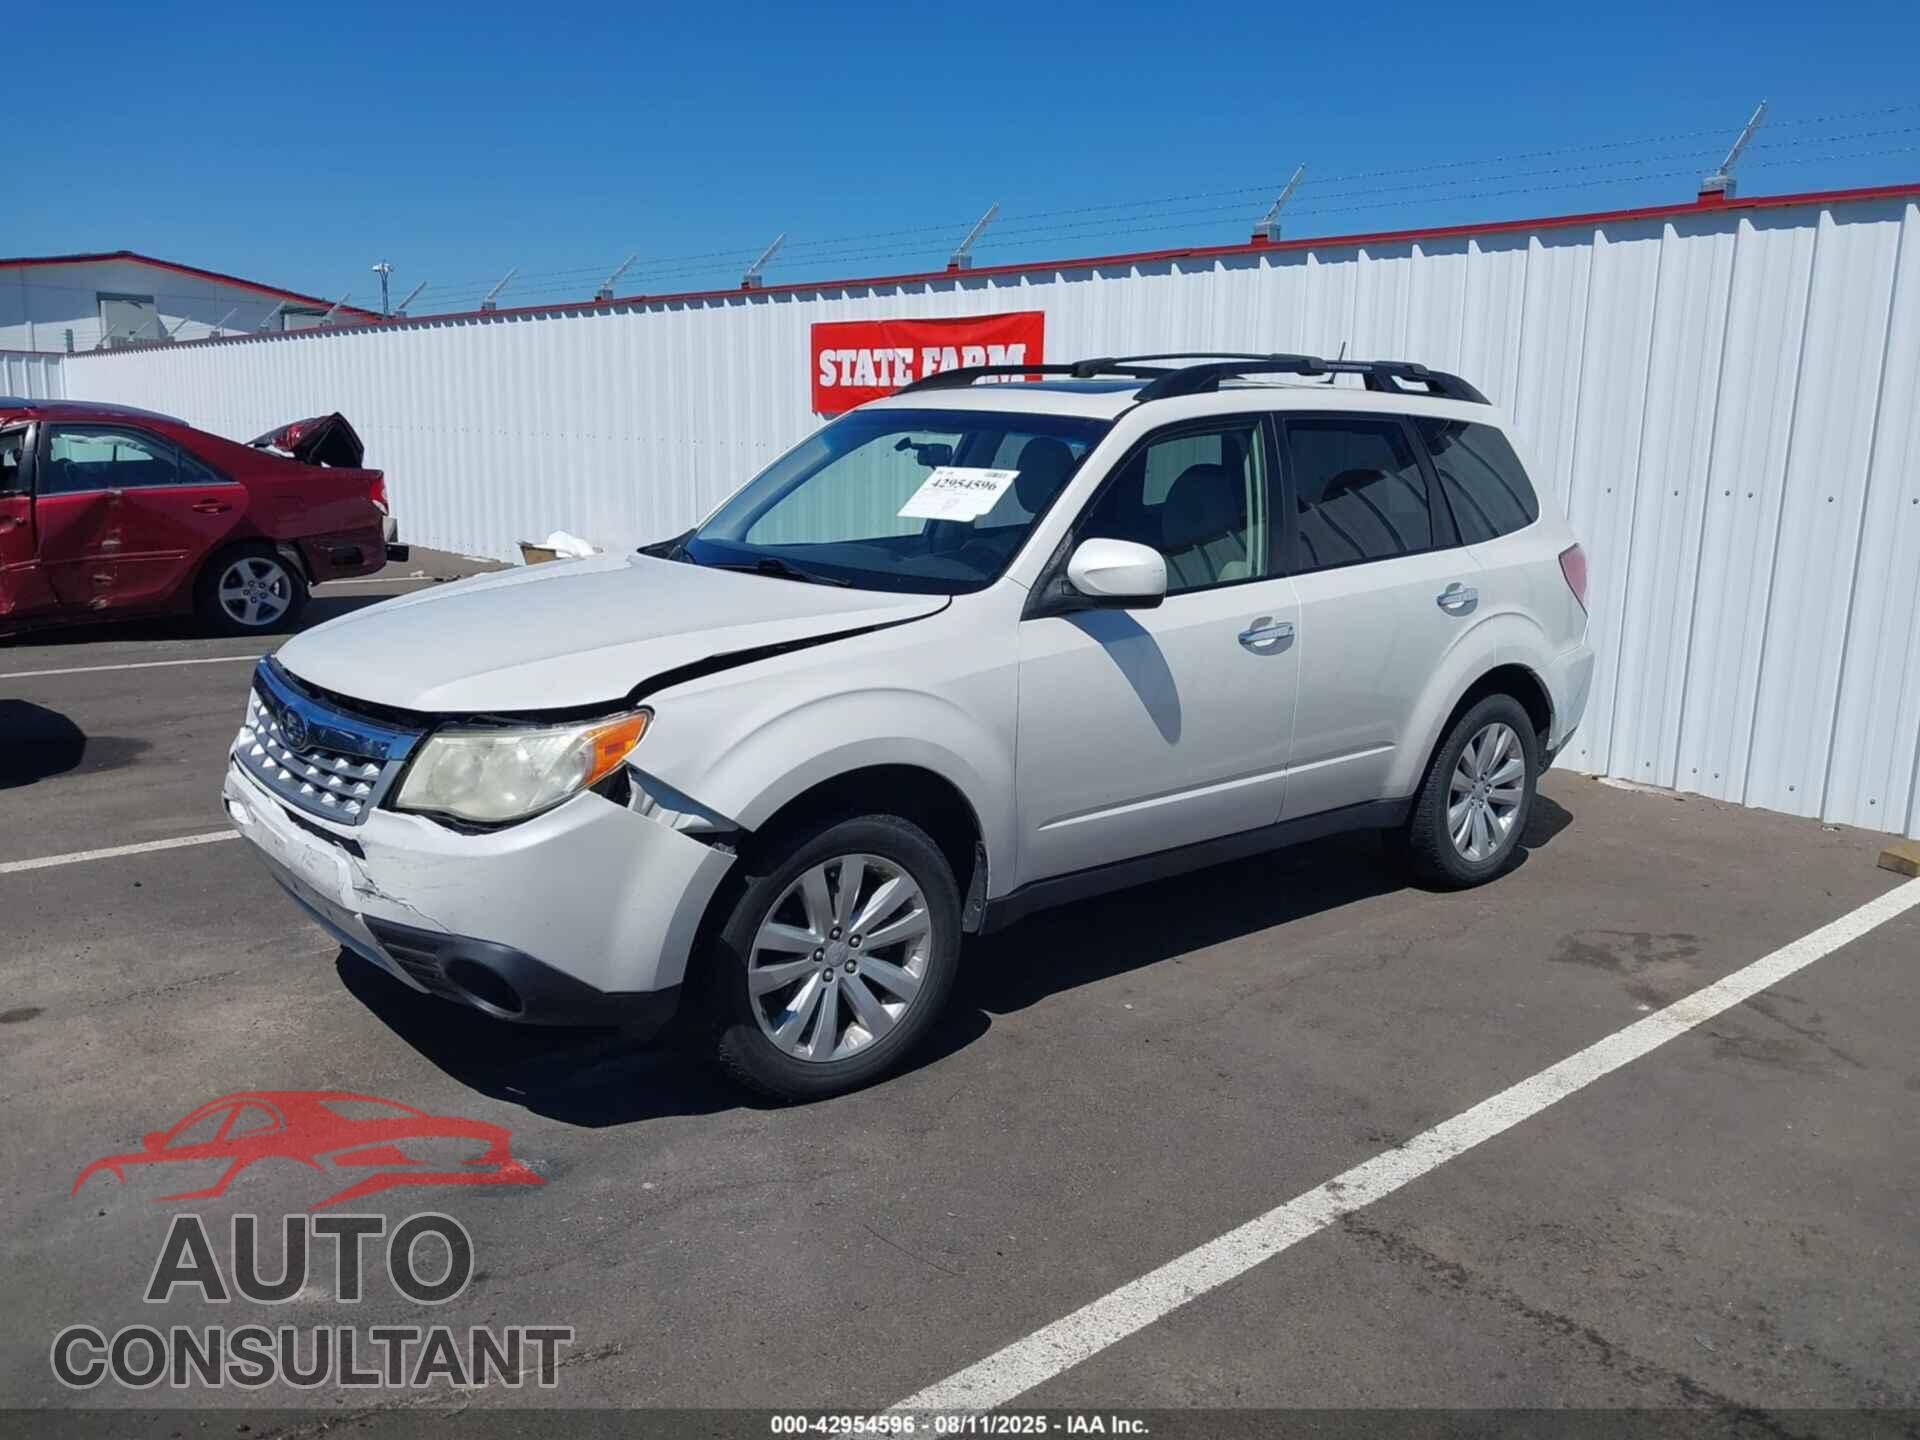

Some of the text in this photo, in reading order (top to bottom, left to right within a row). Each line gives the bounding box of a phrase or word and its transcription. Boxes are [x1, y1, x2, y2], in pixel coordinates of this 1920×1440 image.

[819, 343, 1026, 388] STATE FARM
[930, 478, 998, 492] 42954596
